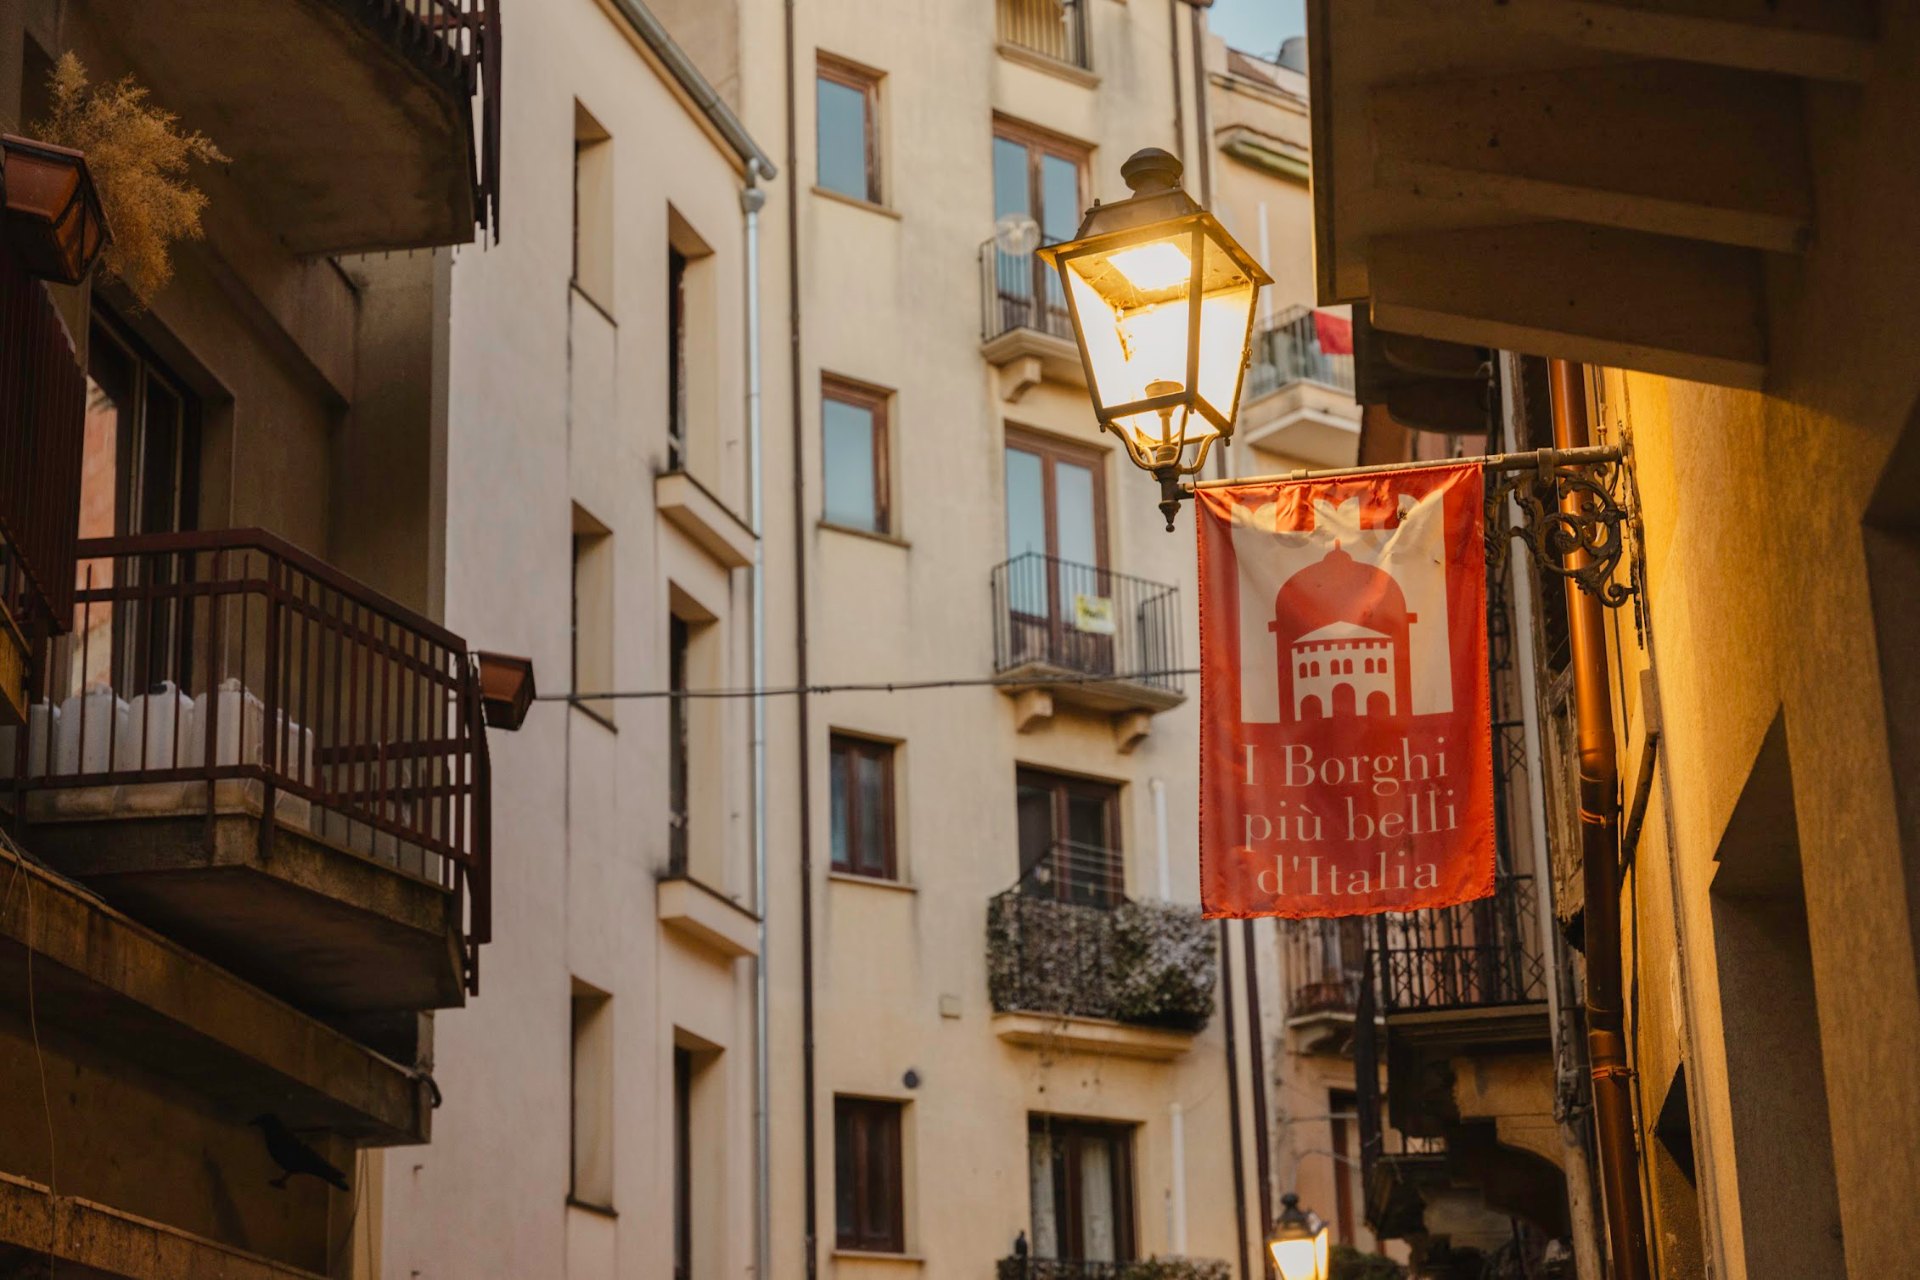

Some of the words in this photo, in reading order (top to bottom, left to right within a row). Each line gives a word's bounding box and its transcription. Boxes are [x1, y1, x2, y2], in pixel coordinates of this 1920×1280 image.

[1242, 744, 1258, 786] I
[1281, 737, 1448, 797] Borghi
[1243, 801, 1325, 853] più
[1344, 789, 1459, 841] belli
[1257, 851, 1440, 896] d'Italia
